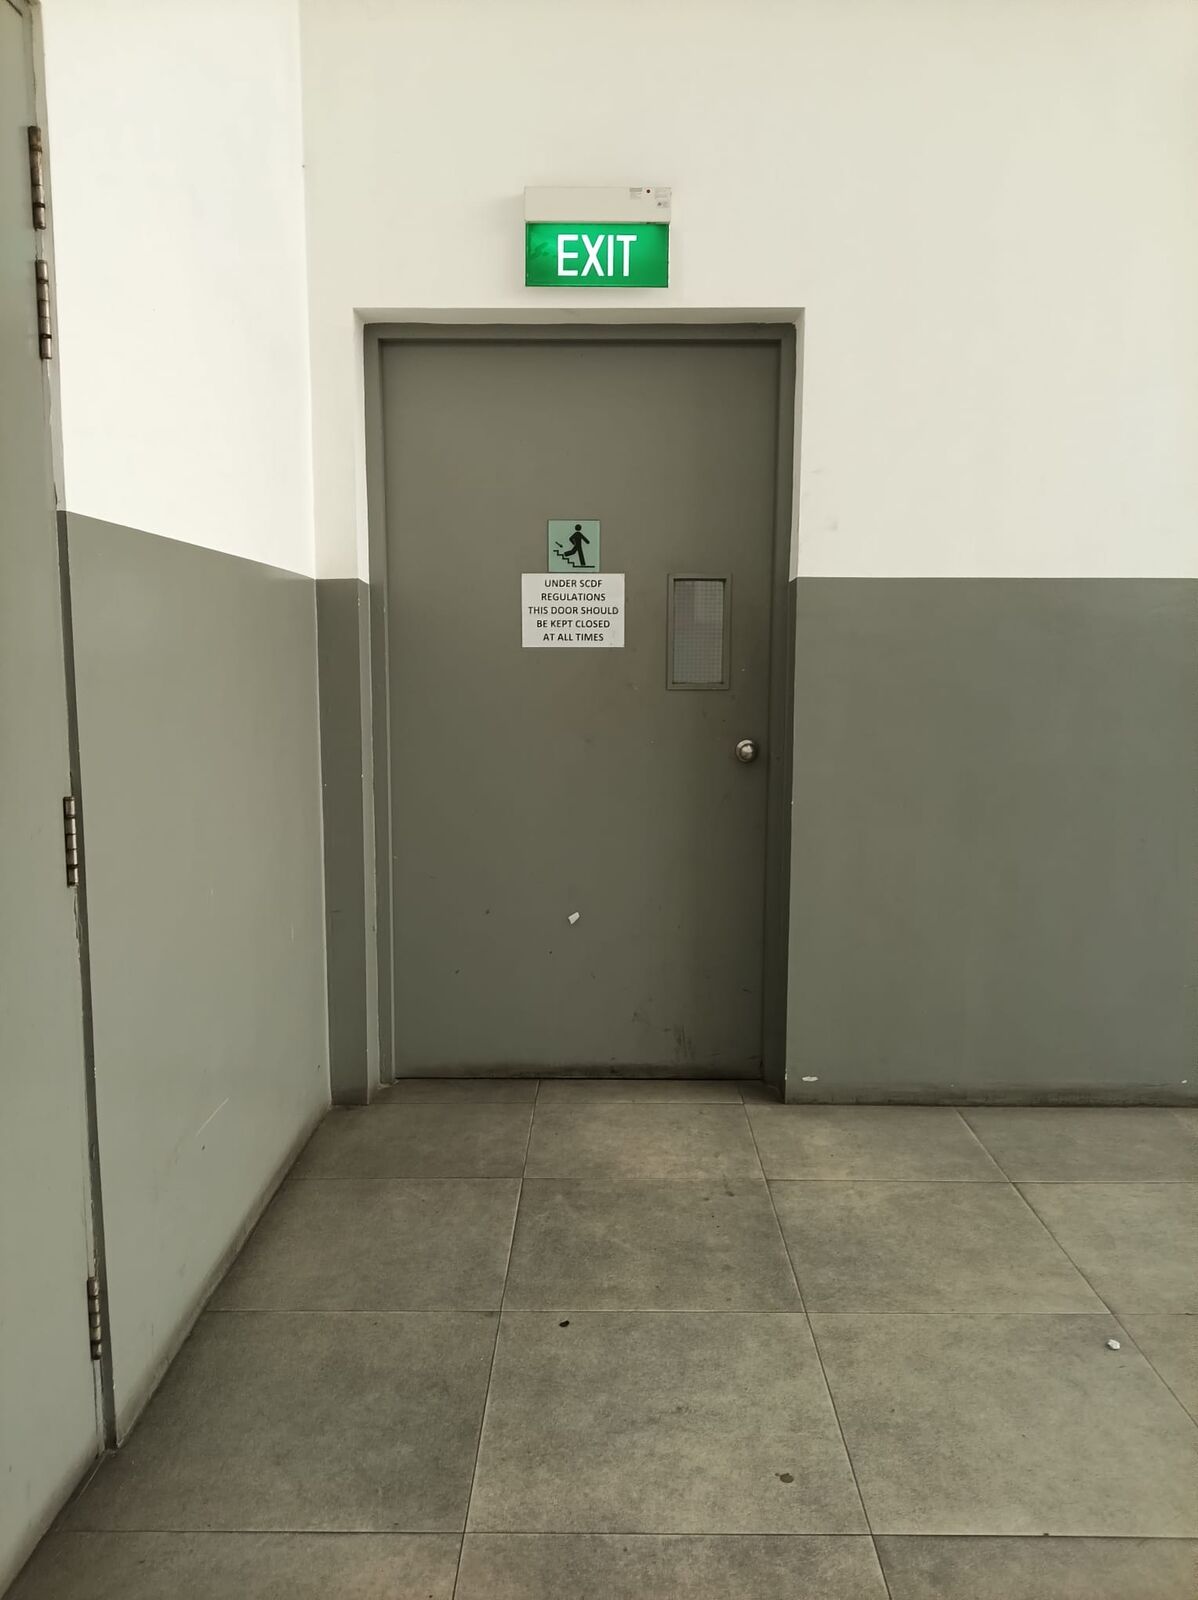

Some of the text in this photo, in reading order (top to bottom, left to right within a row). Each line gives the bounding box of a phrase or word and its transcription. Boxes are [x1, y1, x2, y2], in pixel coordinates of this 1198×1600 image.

[557, 234, 637, 277] EXIT
[544, 579, 603, 588] UNDER SCDF
[541, 593, 606, 602] REGULATIONS
[528, 606, 619, 615] THIS DOOR SHOULD
[536, 620, 610, 628] BE KEPT CLOSED
[543, 633, 604, 642] AT ALL TIMES
